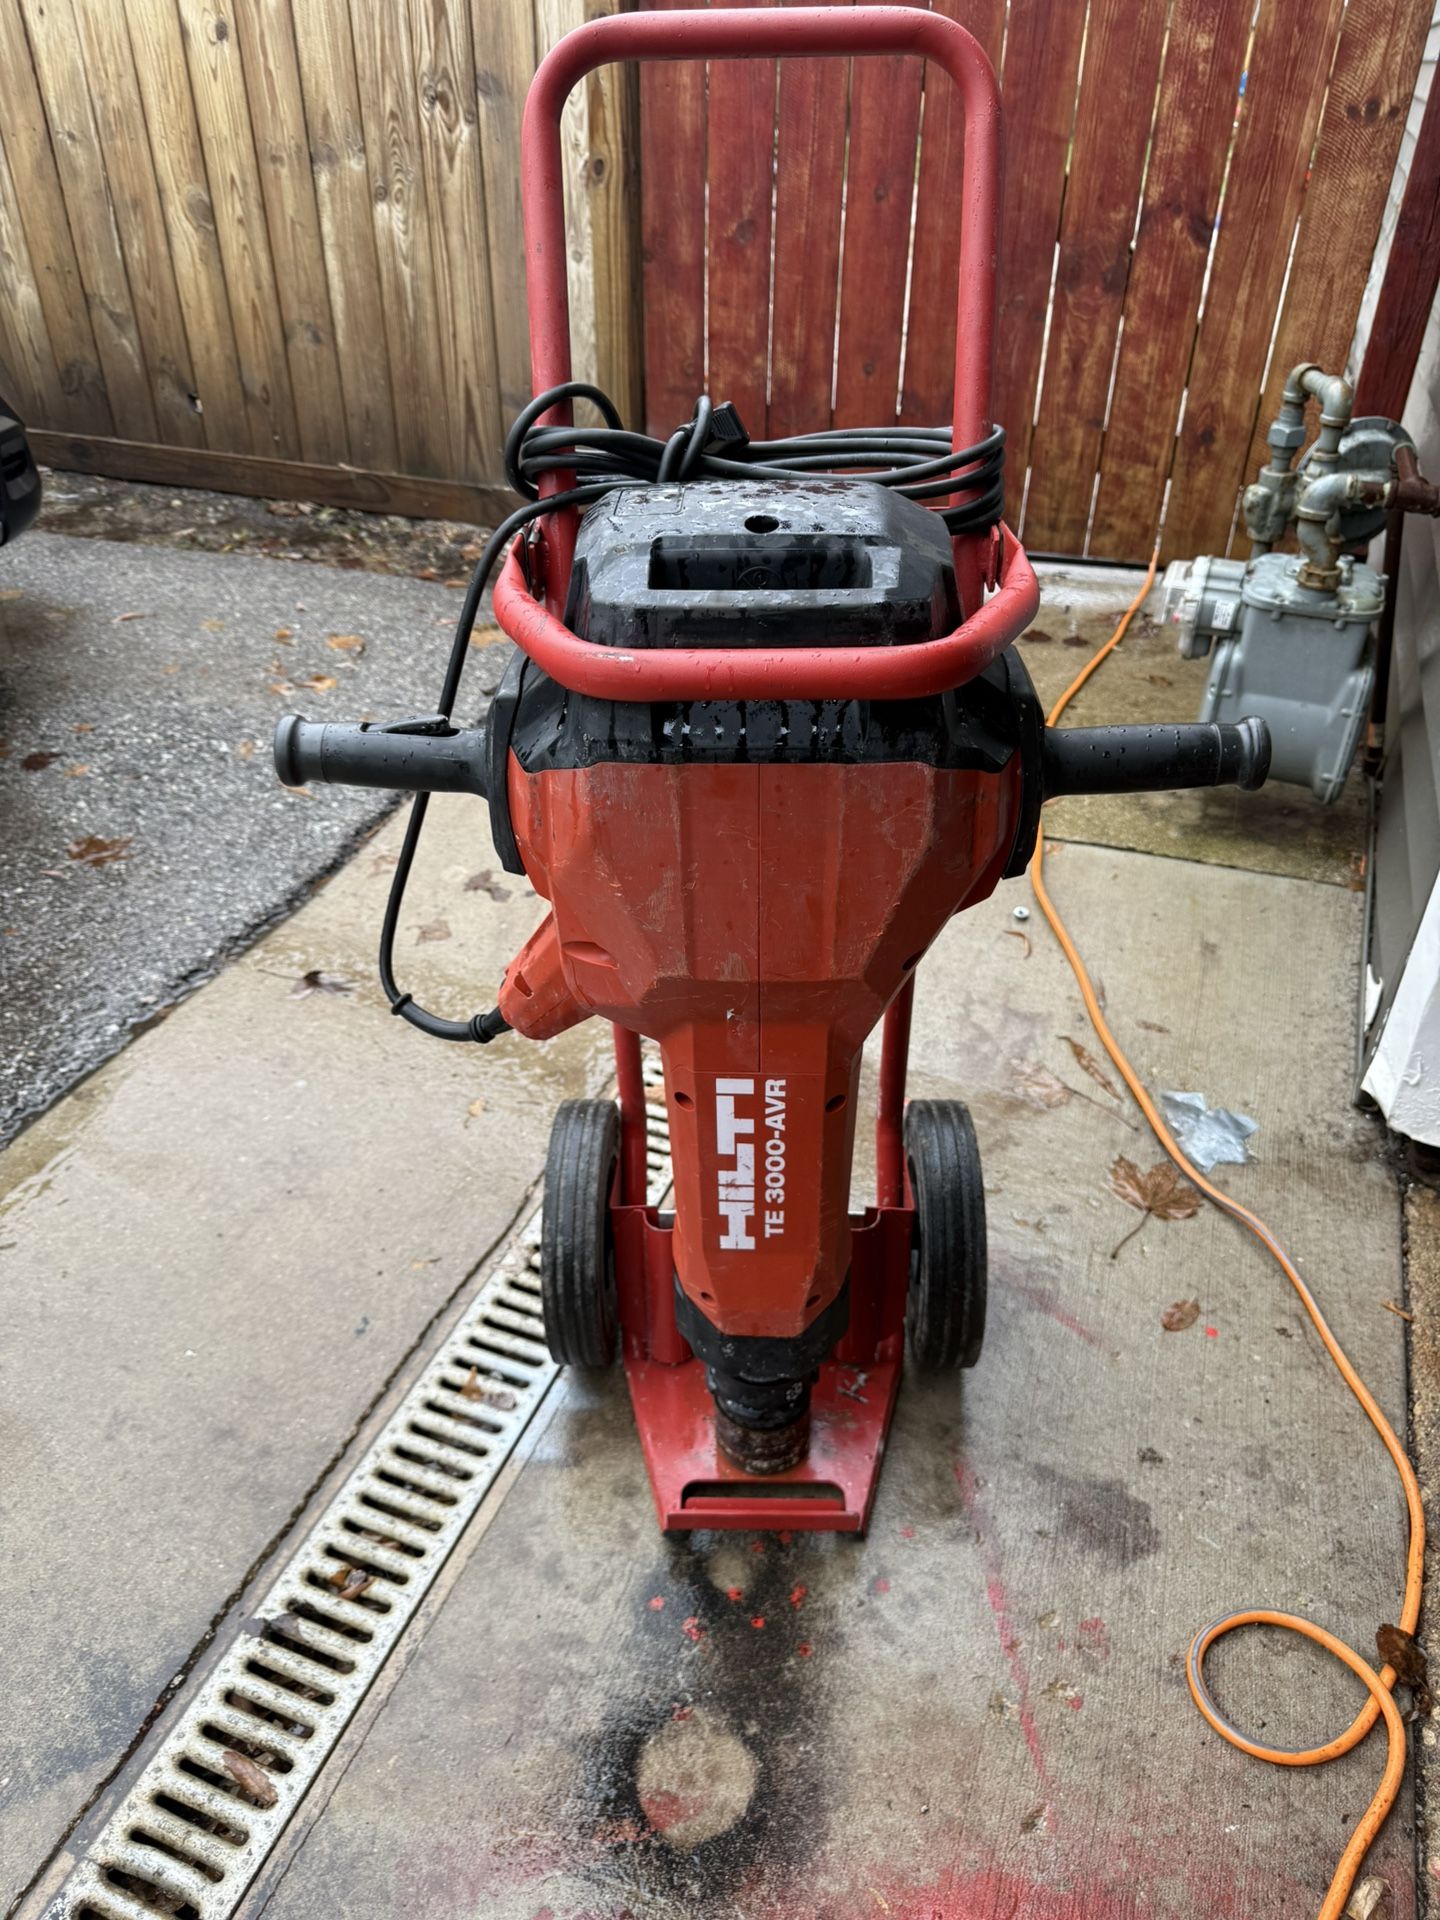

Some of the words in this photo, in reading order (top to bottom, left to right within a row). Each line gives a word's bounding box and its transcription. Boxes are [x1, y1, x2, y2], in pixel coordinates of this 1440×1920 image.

[715, 1077, 756, 1250] HILTI
[764, 1079, 787, 1204] 3000-AVR
[764, 1210, 785, 1238] TE
